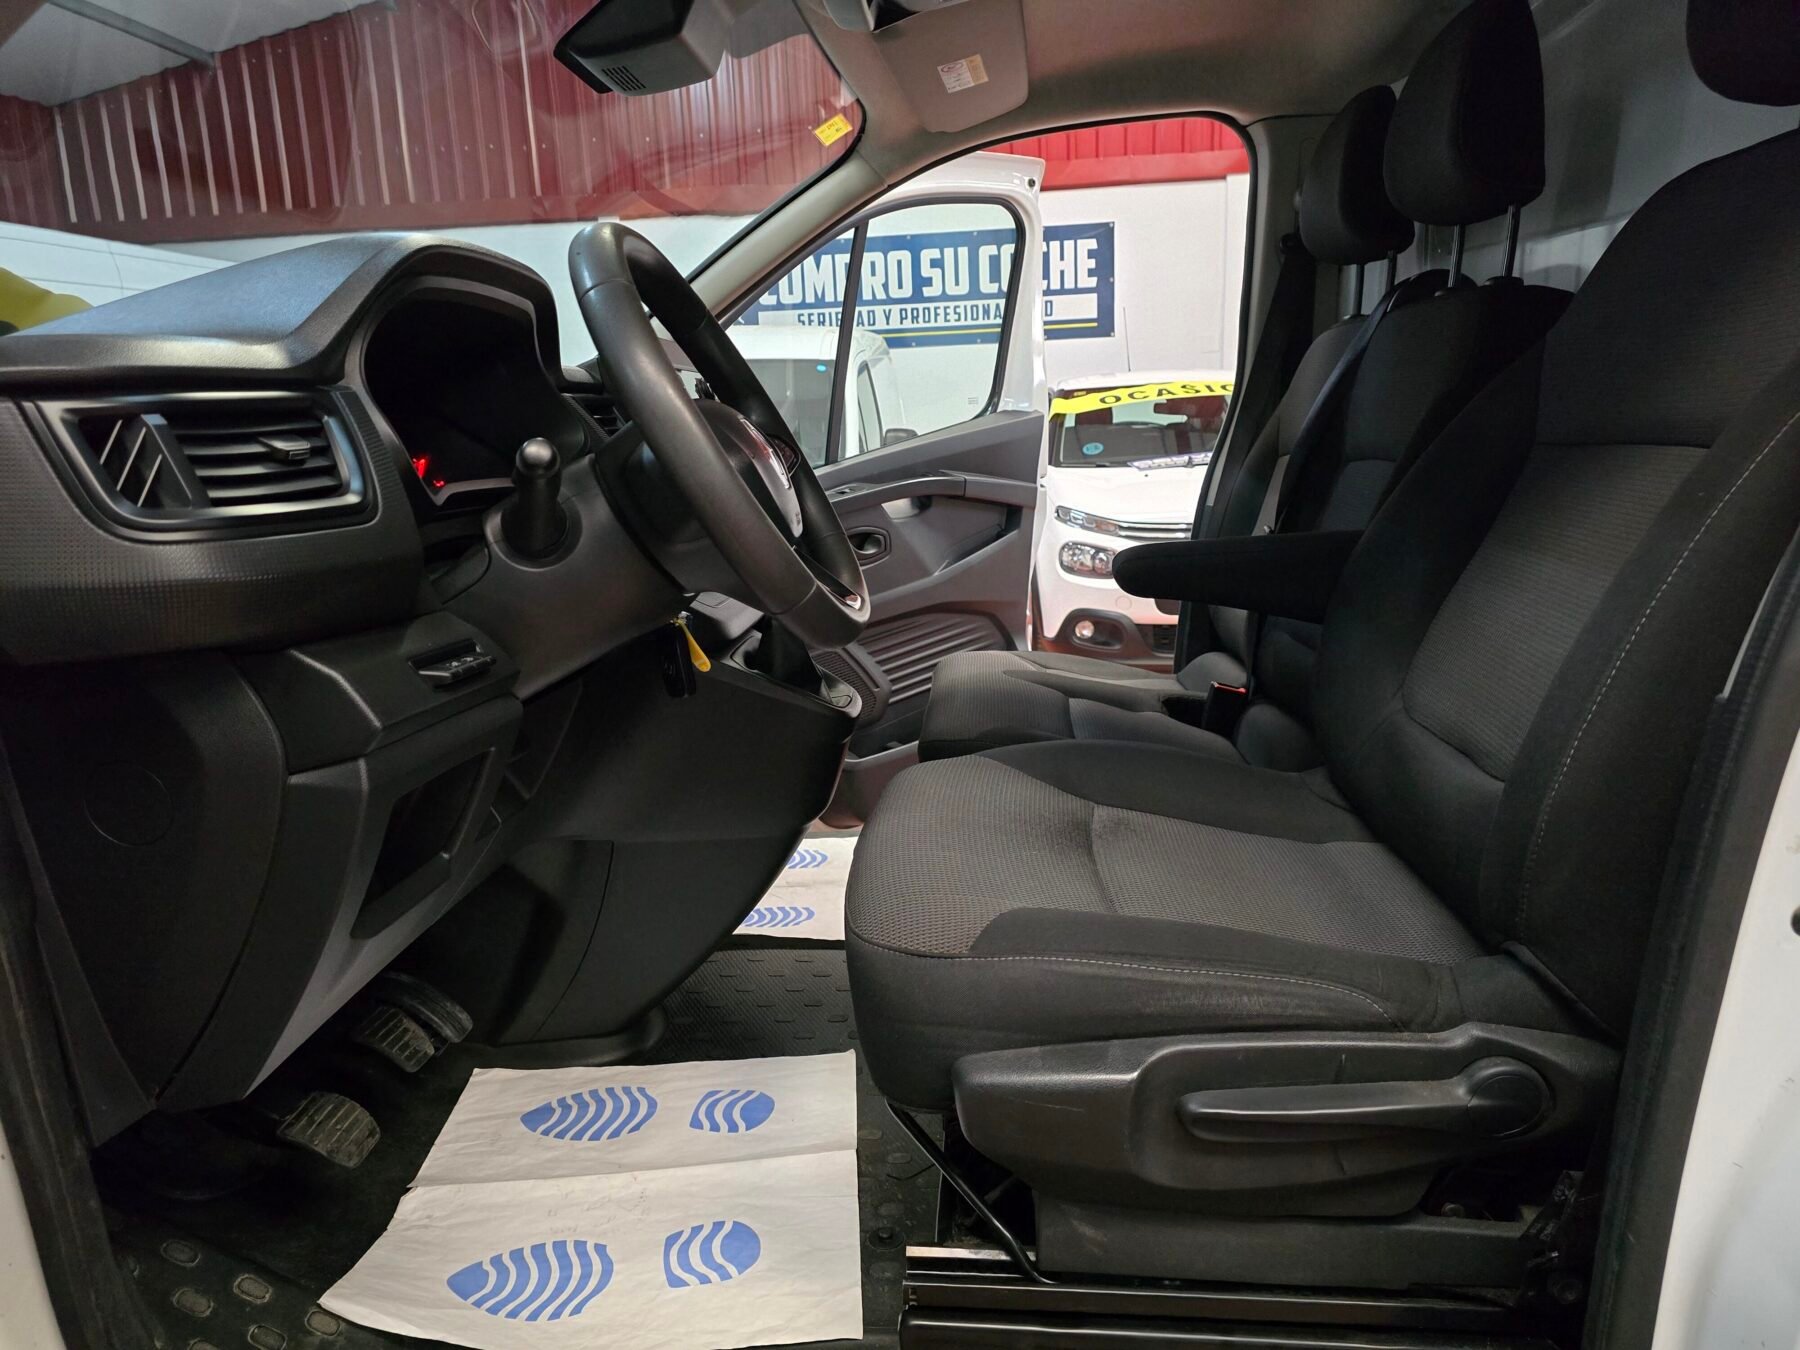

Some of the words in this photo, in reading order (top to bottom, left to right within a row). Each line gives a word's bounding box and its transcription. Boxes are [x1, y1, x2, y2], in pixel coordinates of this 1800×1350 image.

[920, 246, 969, 297] SU
[979, 238, 1098, 294] CHE
[797, 308, 876, 327] SERIEAD
[882, 308, 892, 326] Y
